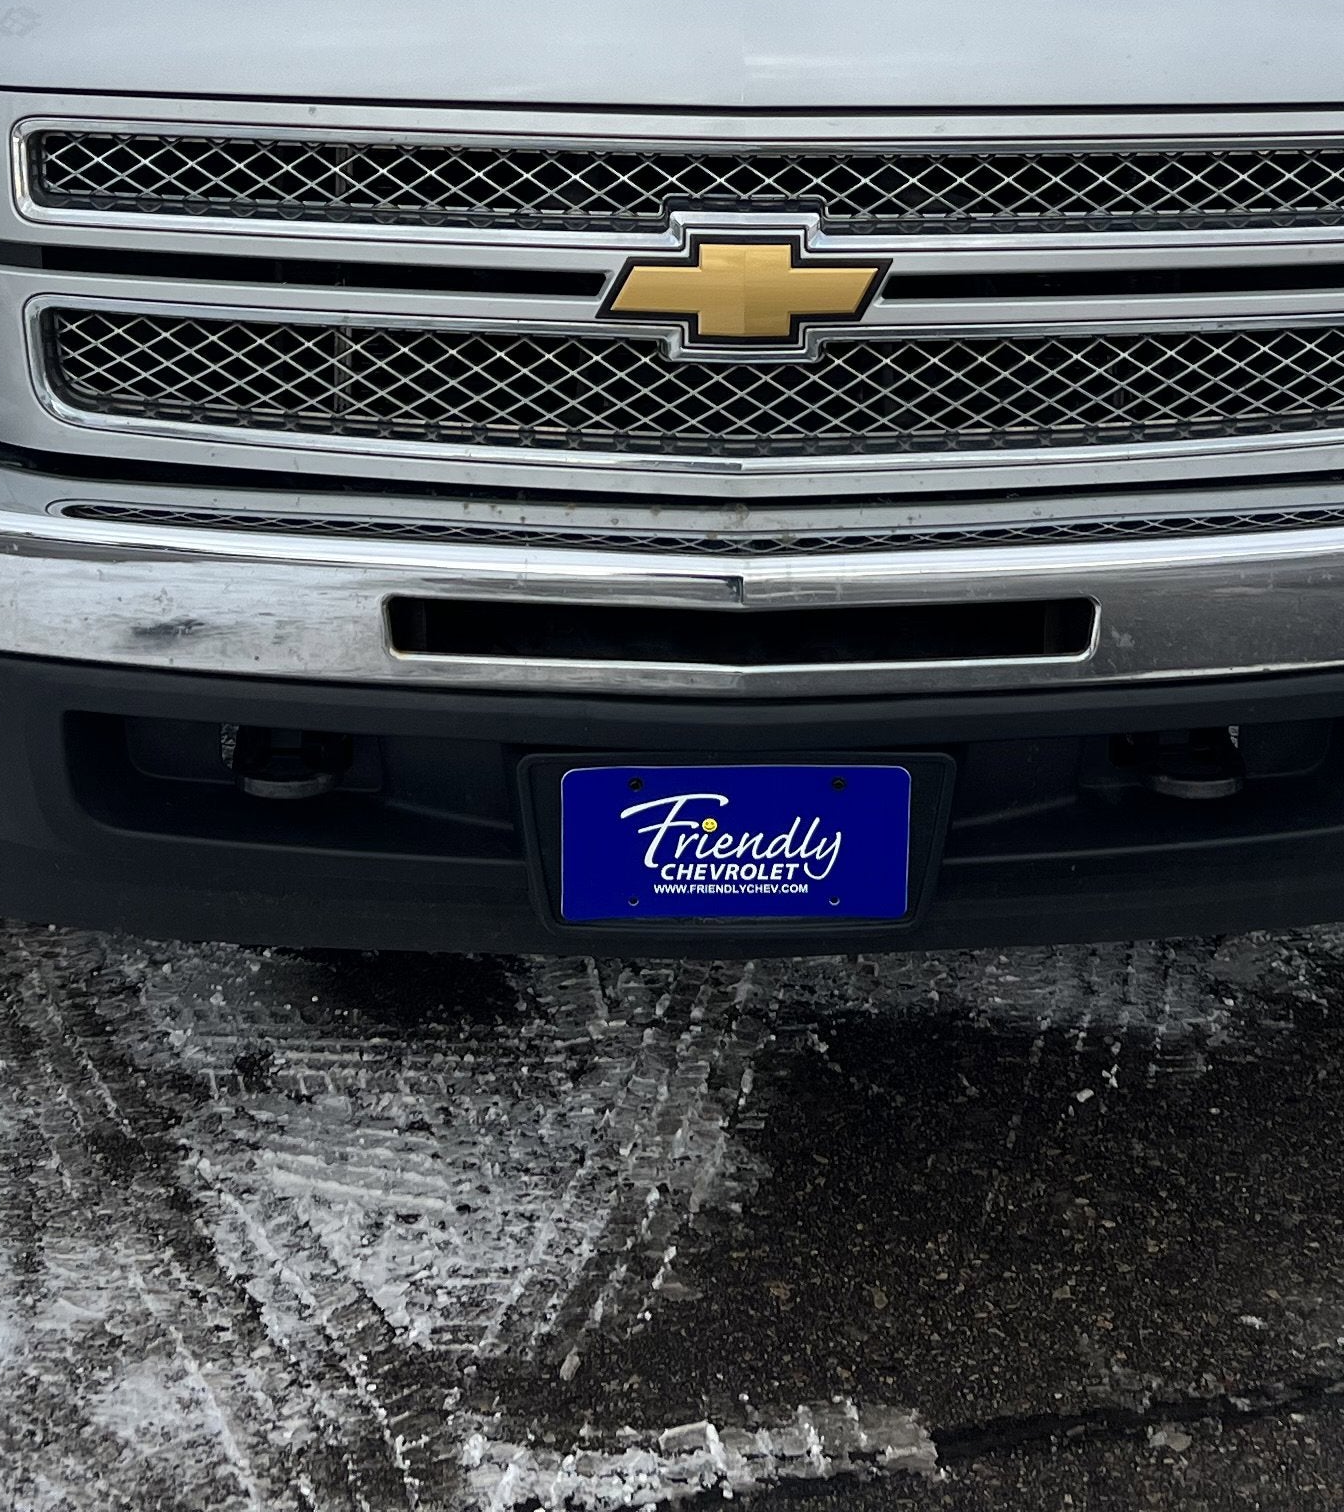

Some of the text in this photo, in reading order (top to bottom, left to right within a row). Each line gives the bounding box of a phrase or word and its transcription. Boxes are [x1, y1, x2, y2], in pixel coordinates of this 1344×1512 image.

[620, 793, 842, 880] Friendly
[660, 863, 800, 881] CHEVROLET
[653, 883, 809, 894] WWW.FRIENDLYCHEV.COM
